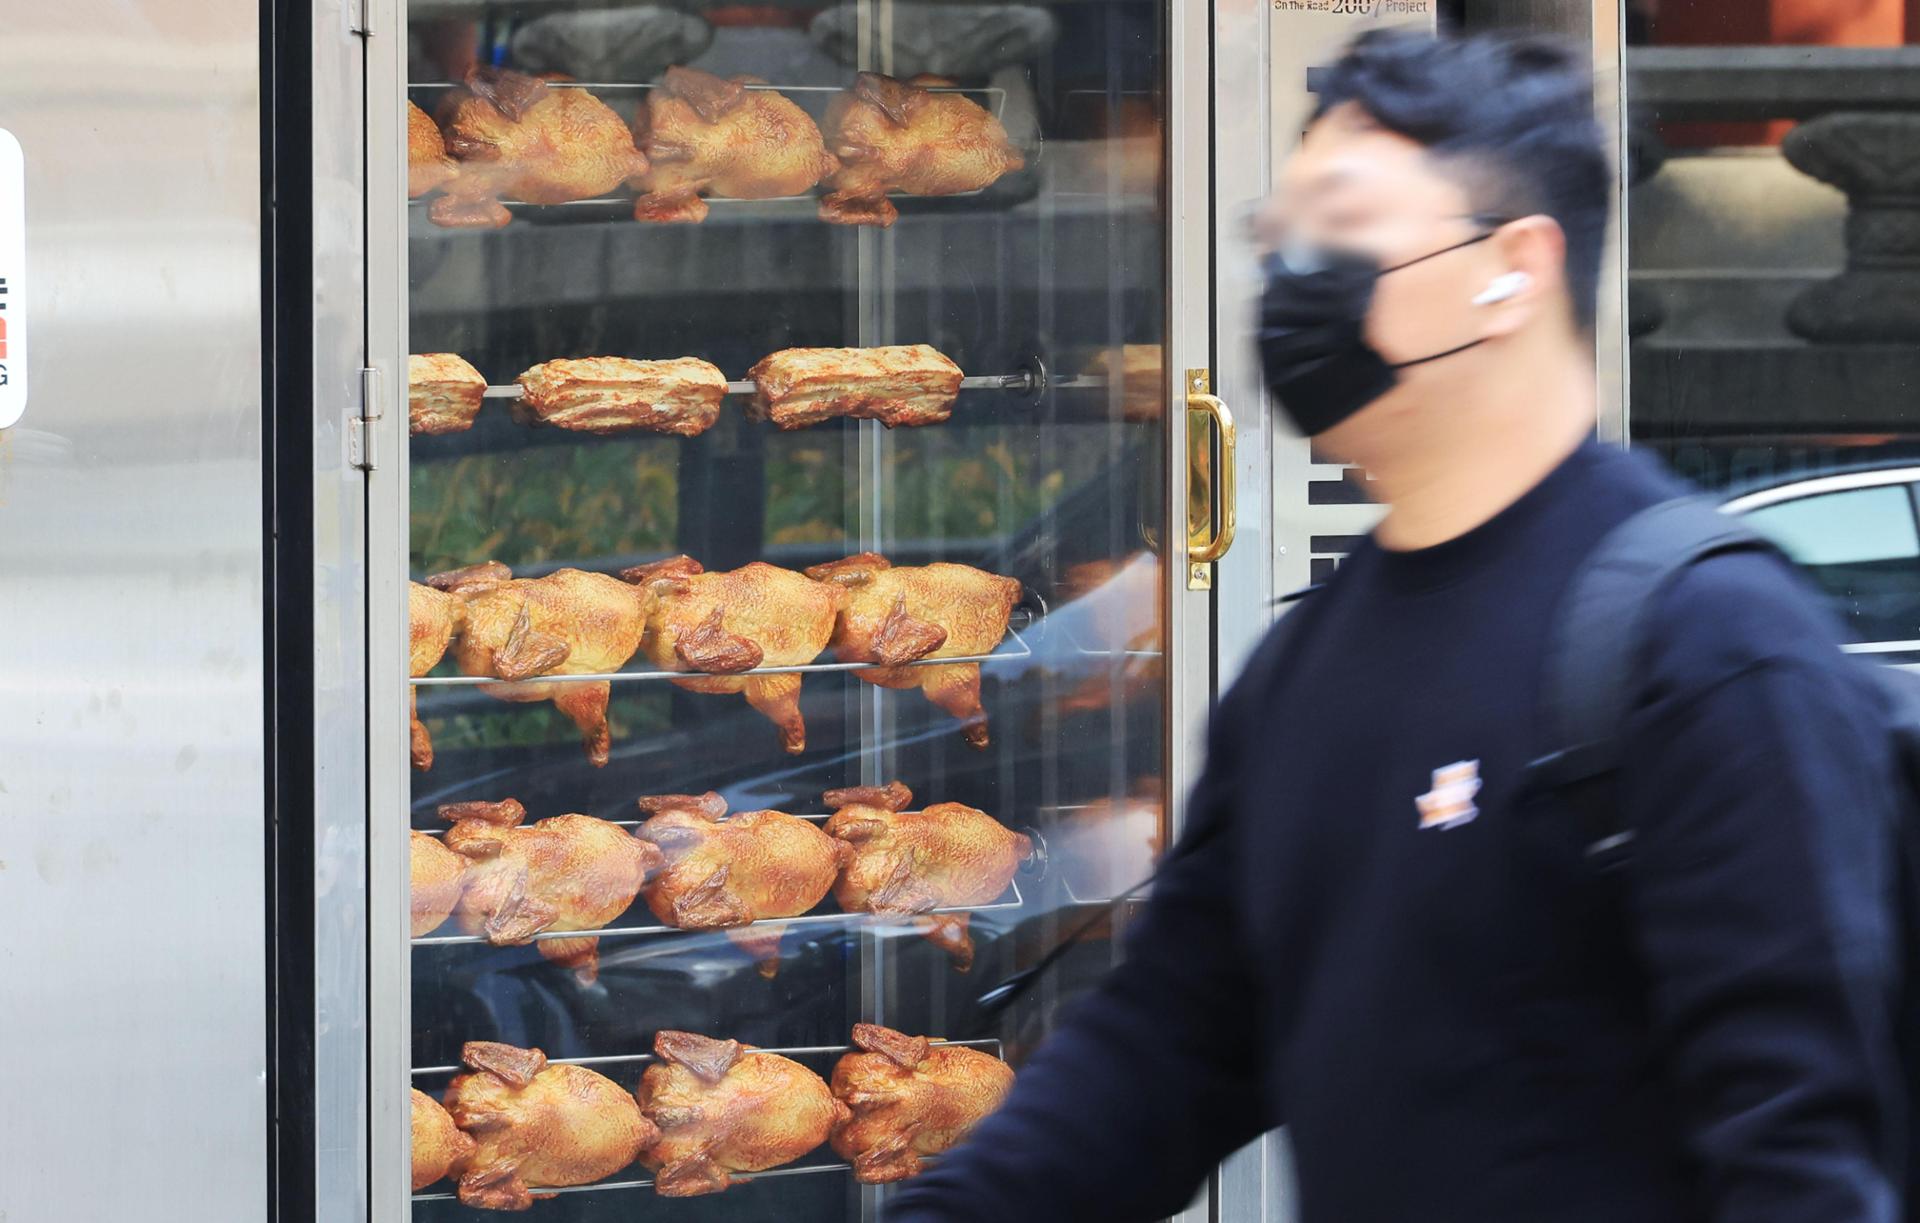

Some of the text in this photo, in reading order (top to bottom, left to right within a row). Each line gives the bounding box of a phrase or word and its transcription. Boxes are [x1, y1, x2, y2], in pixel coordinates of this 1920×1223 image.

[1274, 0, 1288, 10] On
[1289, 1, 1305, 10] The
[1386, 0, 1428, 14] Project
